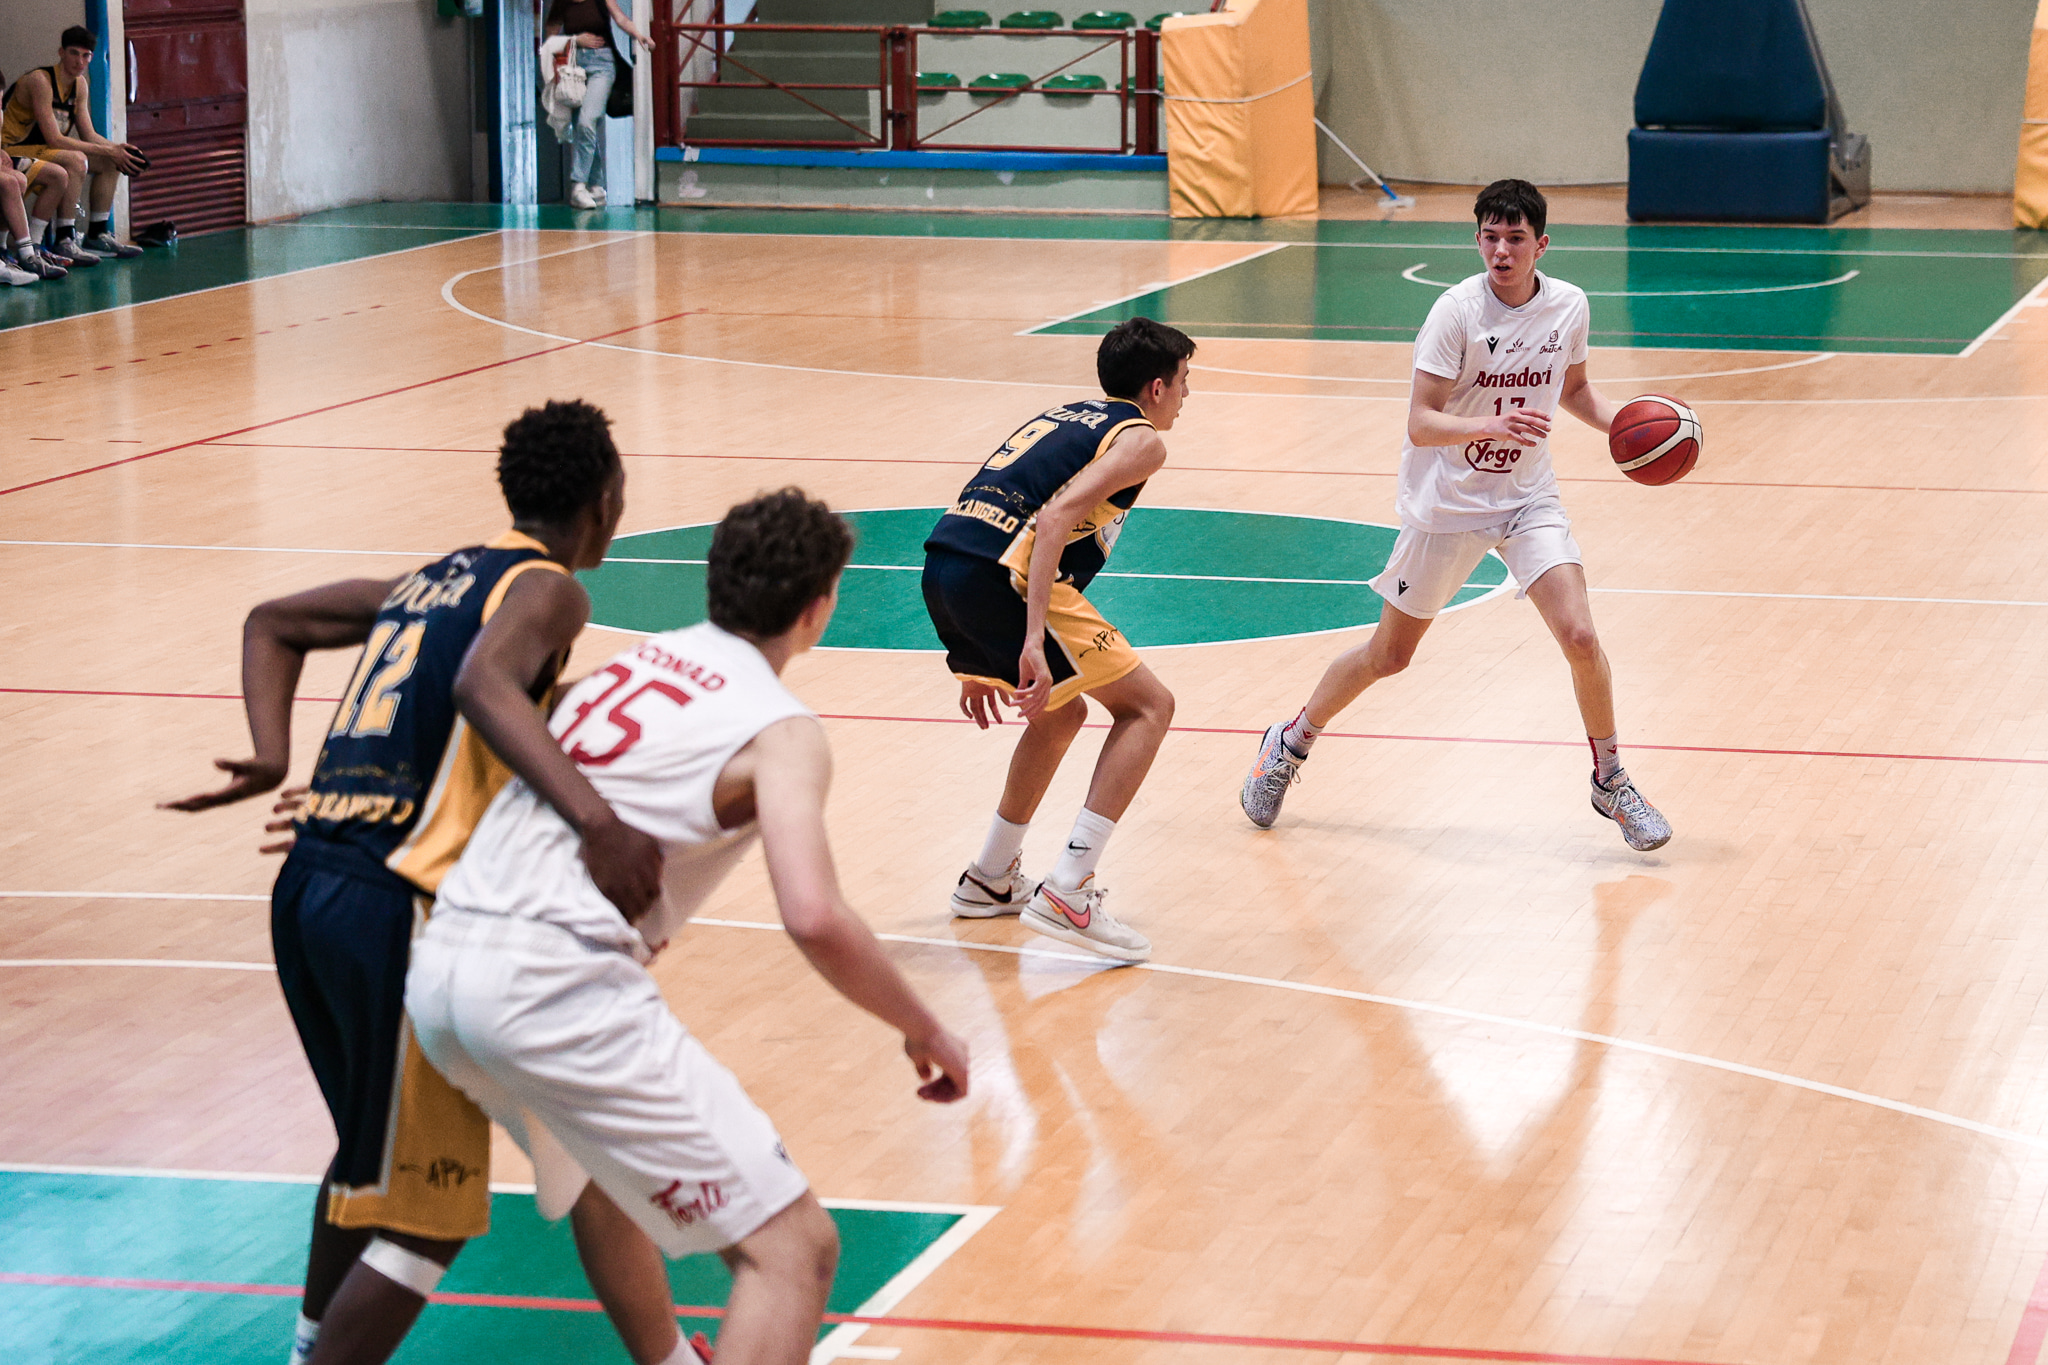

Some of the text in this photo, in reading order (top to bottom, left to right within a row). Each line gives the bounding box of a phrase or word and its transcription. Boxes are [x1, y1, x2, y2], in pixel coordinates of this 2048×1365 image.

[1471, 364, 1553, 388] Amadori
[984, 418, 1059, 471] 9
[328, 619, 428, 739] 12
